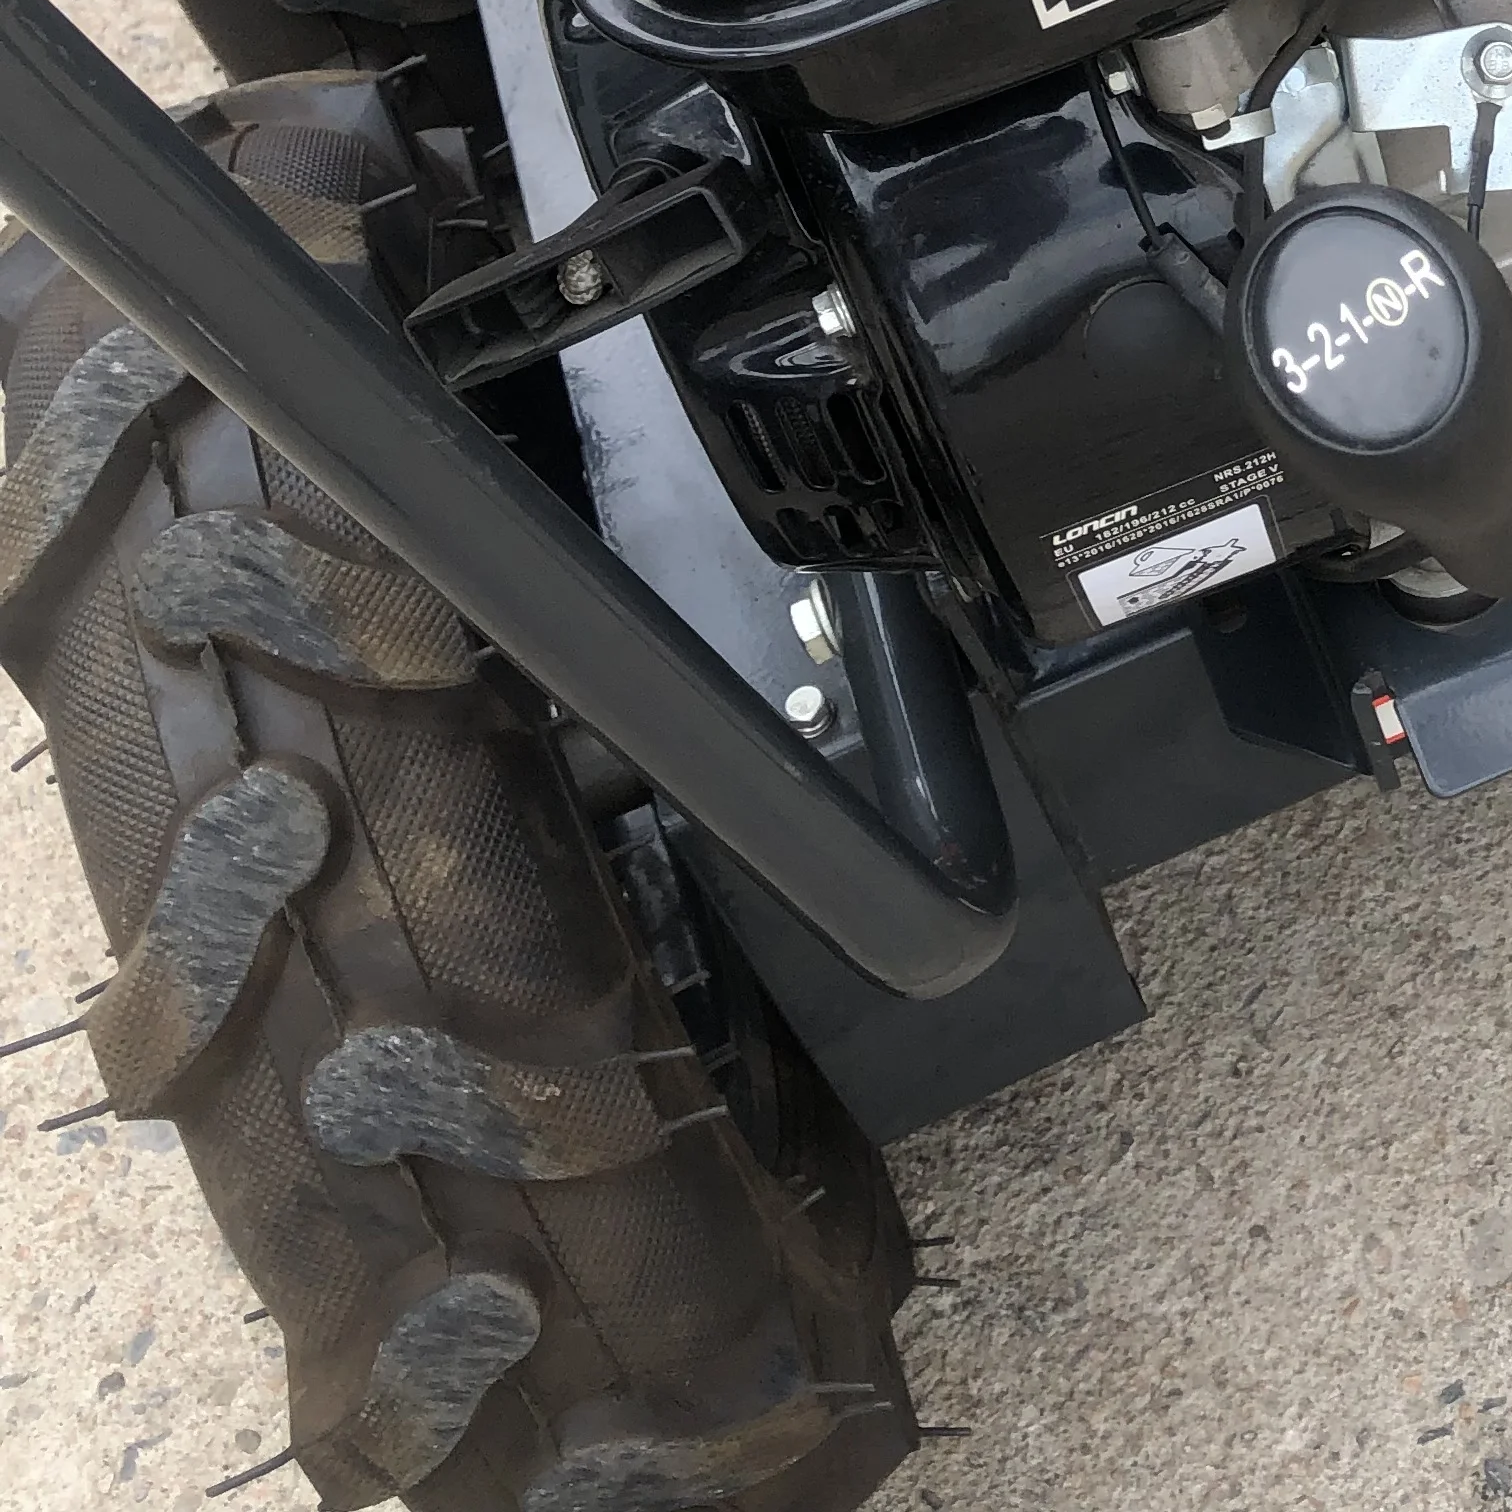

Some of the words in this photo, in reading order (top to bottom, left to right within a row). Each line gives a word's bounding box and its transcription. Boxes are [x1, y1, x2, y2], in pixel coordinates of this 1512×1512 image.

[1214, 451, 1277, 483] NRS.212H
[1219, 469, 1267, 494] STAGE
[1268, 463, 1279, 474] V
[1053, 544, 1075, 558] EU
[1178, 498, 1197, 509] cc
